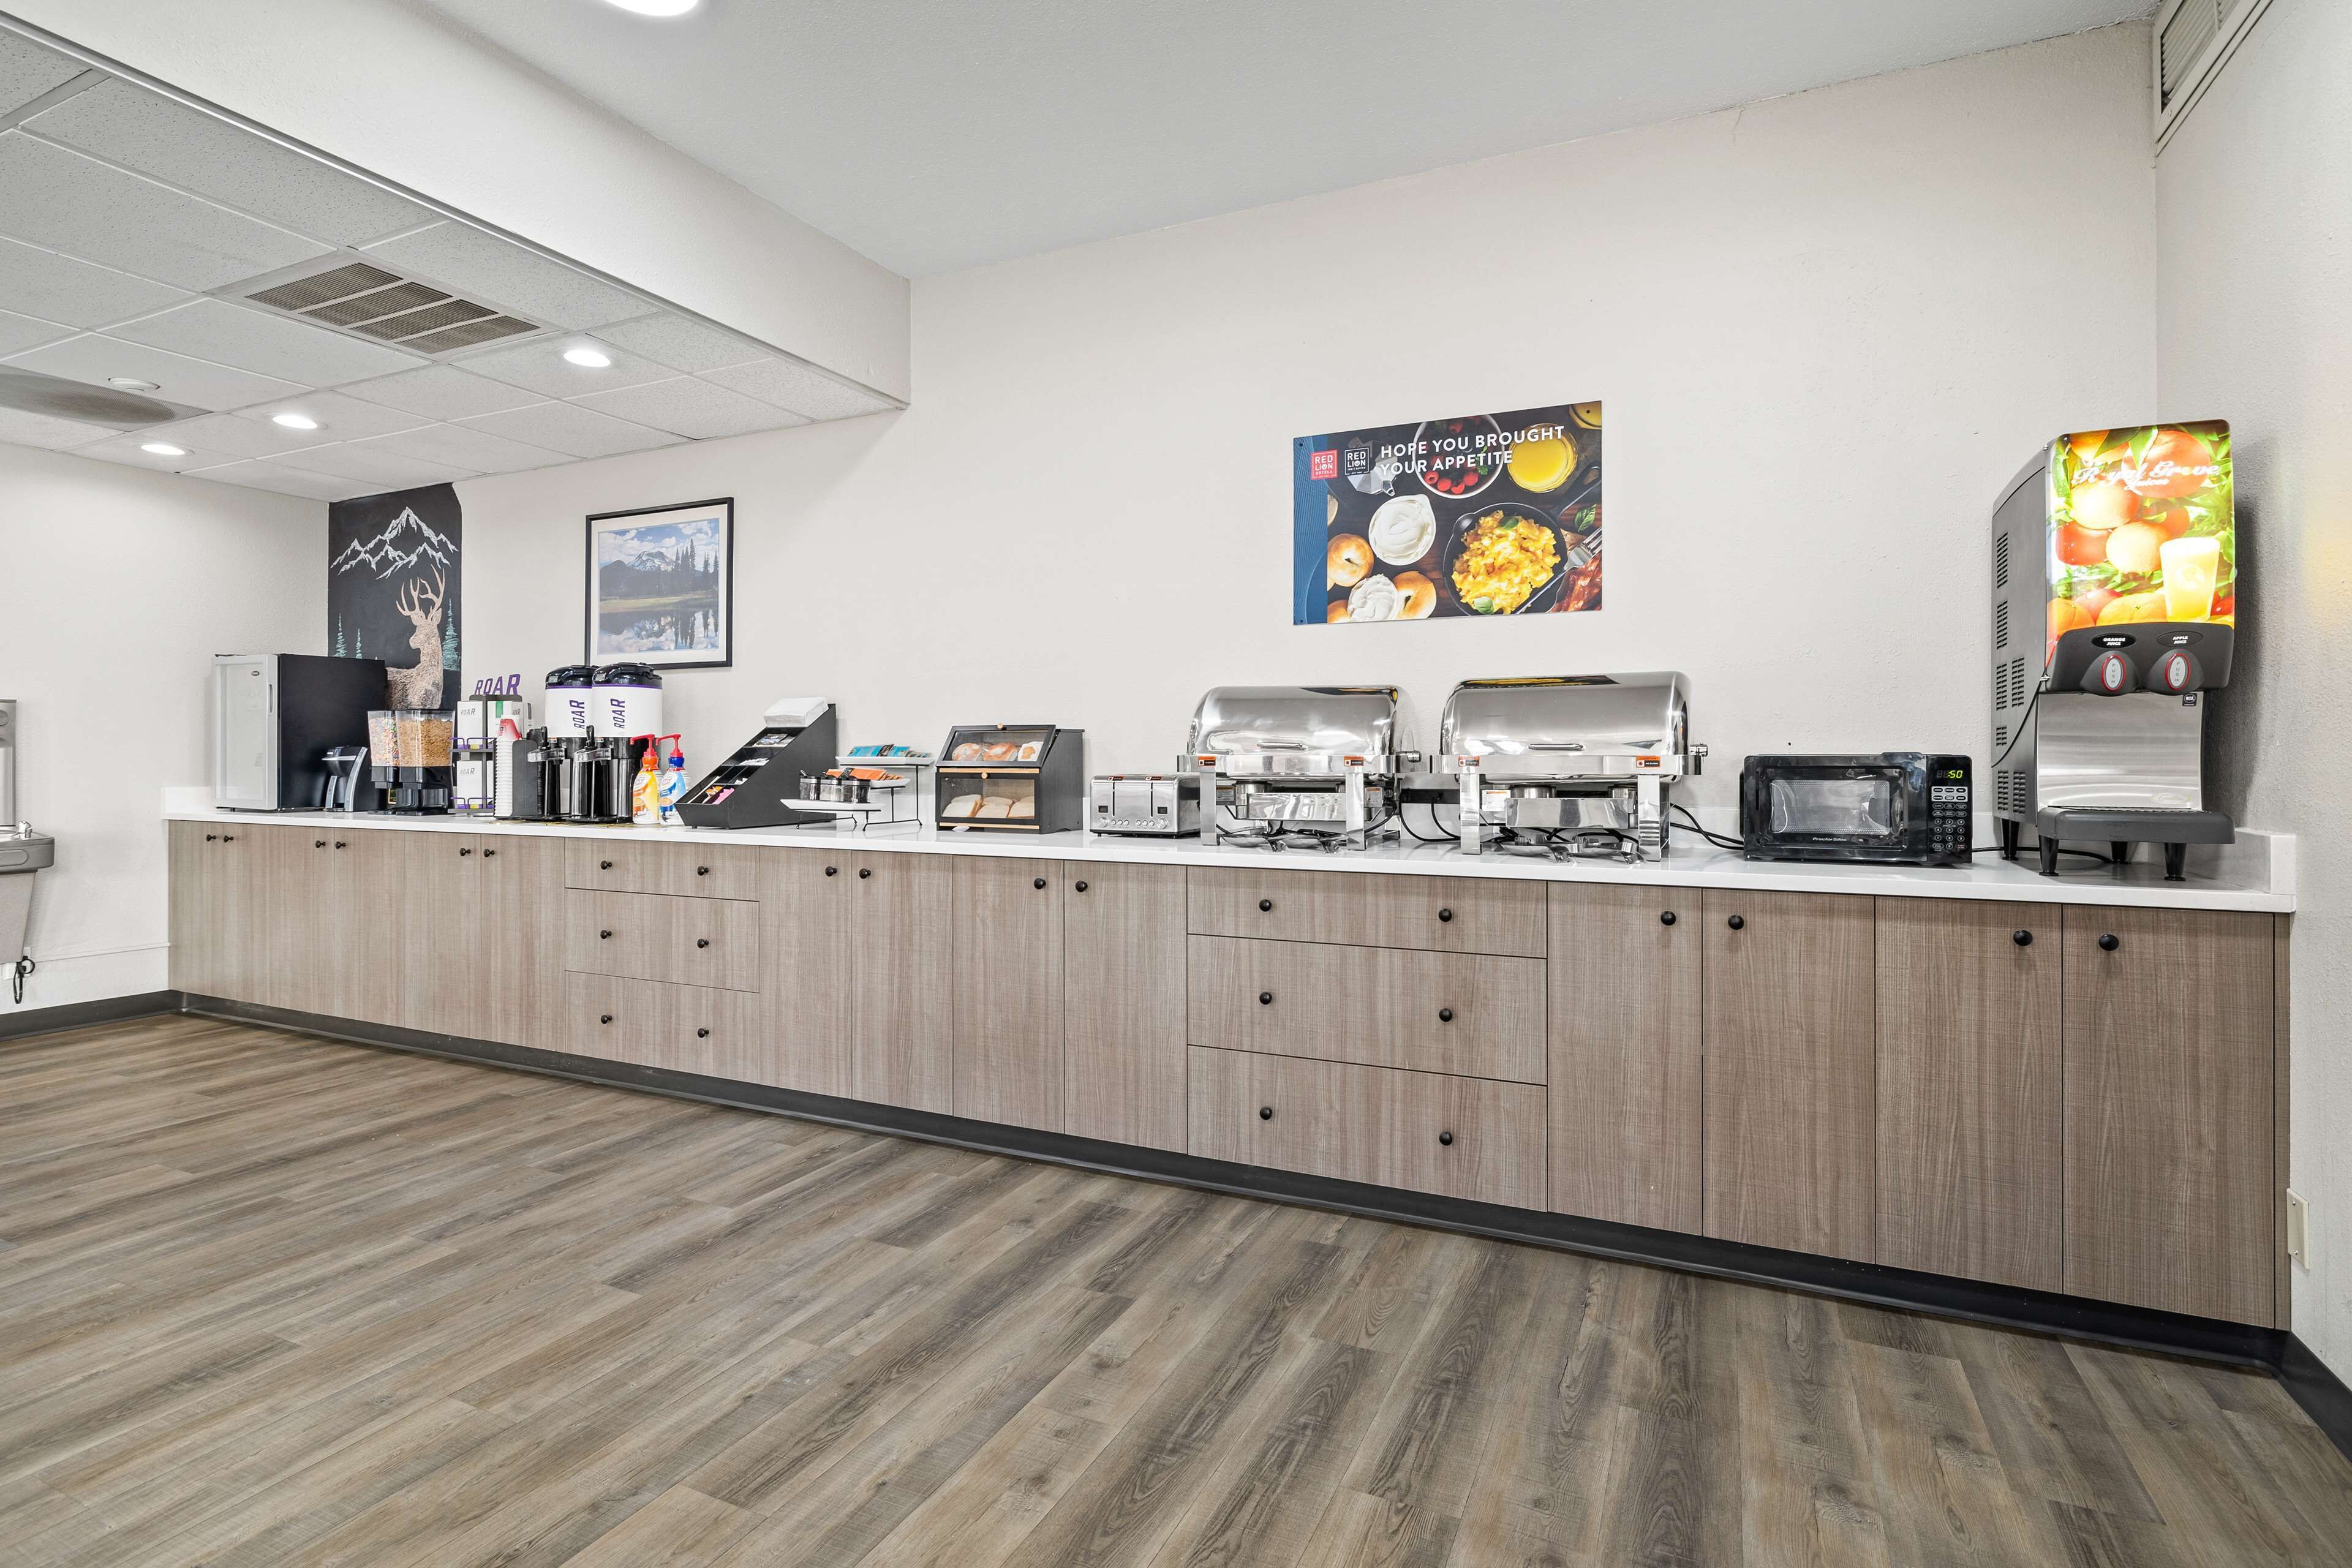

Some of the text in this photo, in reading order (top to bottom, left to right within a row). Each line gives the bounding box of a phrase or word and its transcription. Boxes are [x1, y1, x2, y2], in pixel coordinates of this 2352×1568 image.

[1381, 426, 1564, 458] HOPE YOU BROUGHT
[1315, 455, 1333, 464] RED
[1348, 451, 1366, 461] RED
[1380, 450, 1513, 475] YOUR APPETITE
[2071, 462, 2148, 486] Ryal
[475, 674, 521, 695] ROAR
[569, 699, 585, 729] ROAR
[610, 698, 625, 729] ROAR
